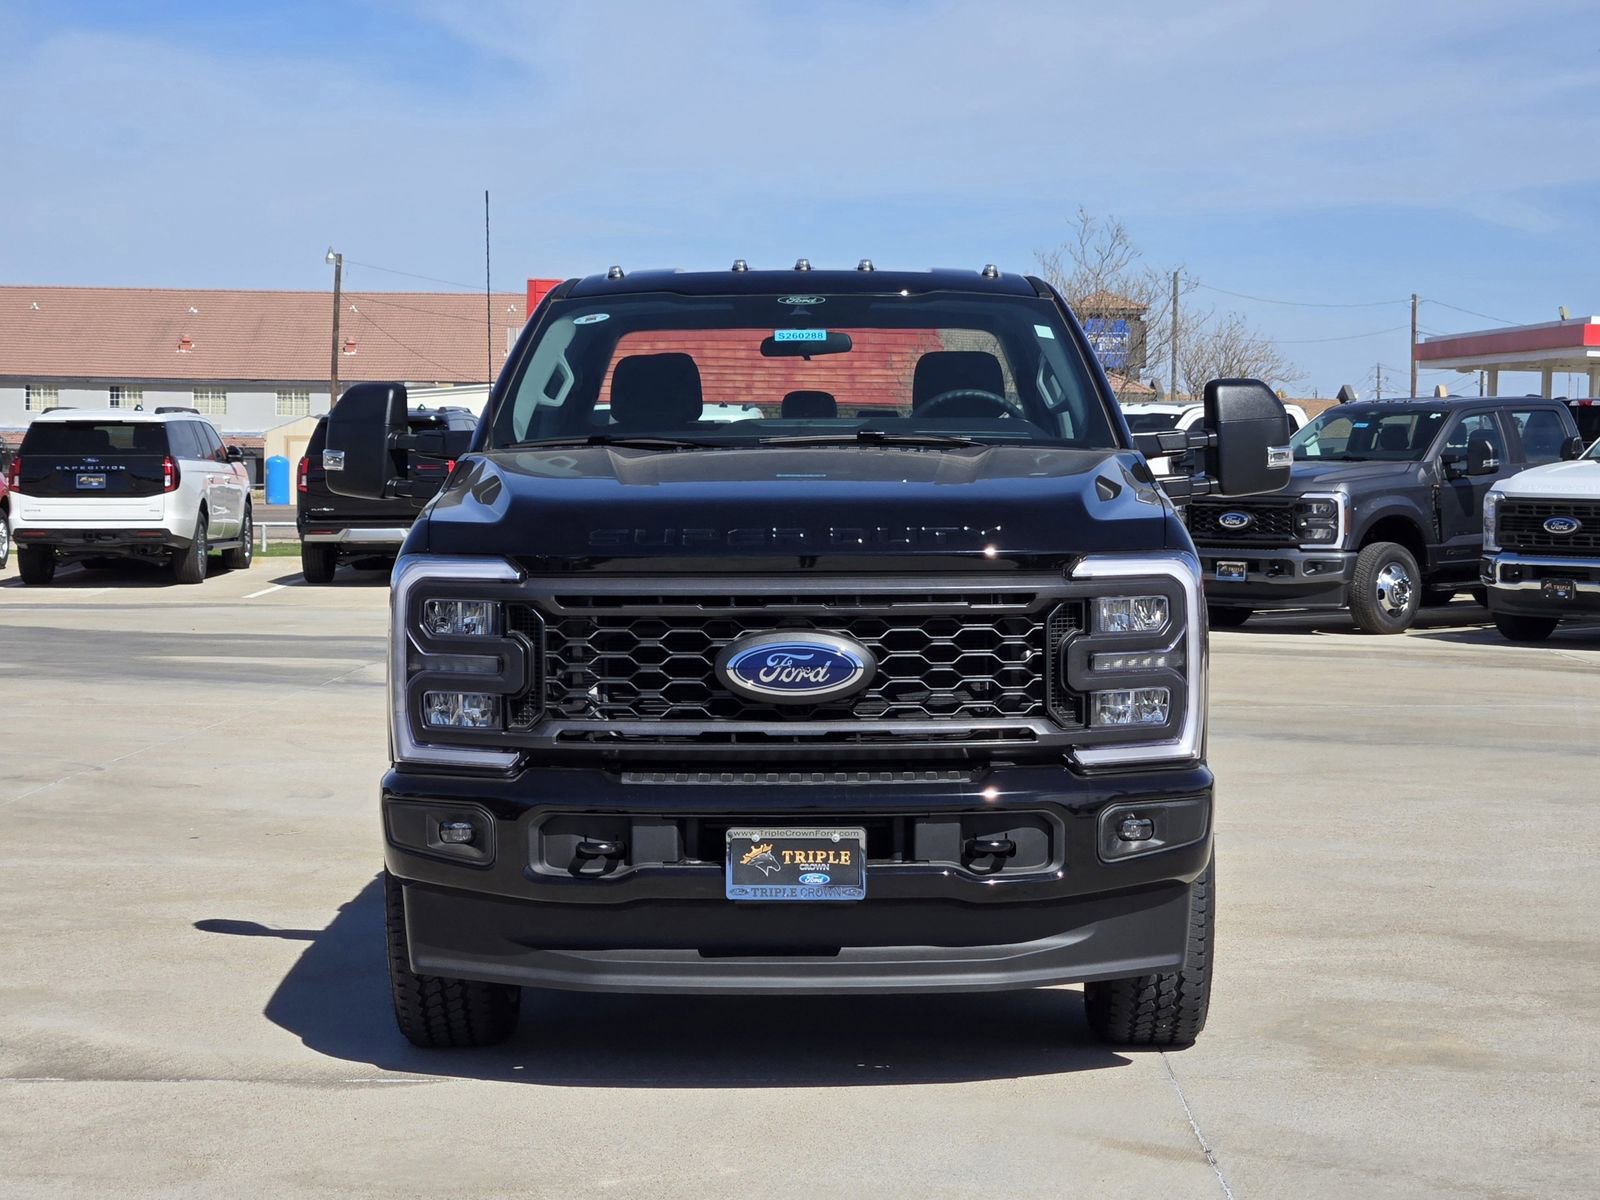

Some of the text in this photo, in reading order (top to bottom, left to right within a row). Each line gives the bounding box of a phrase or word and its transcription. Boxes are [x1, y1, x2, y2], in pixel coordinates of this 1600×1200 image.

[786, 296, 817, 305] Ford
[778, 332, 824, 340] S260288
[829, 526, 1001, 546] DUTY
[759, 653, 832, 683] Ford
[733, 830, 859, 838] wwwTripleCrownFordcom
[782, 850, 851, 865] TRIPLE
[799, 863, 830, 871] CROWN
[750, 887, 798, 898] TRIPLE
[800, 887, 841, 898] CROWN
